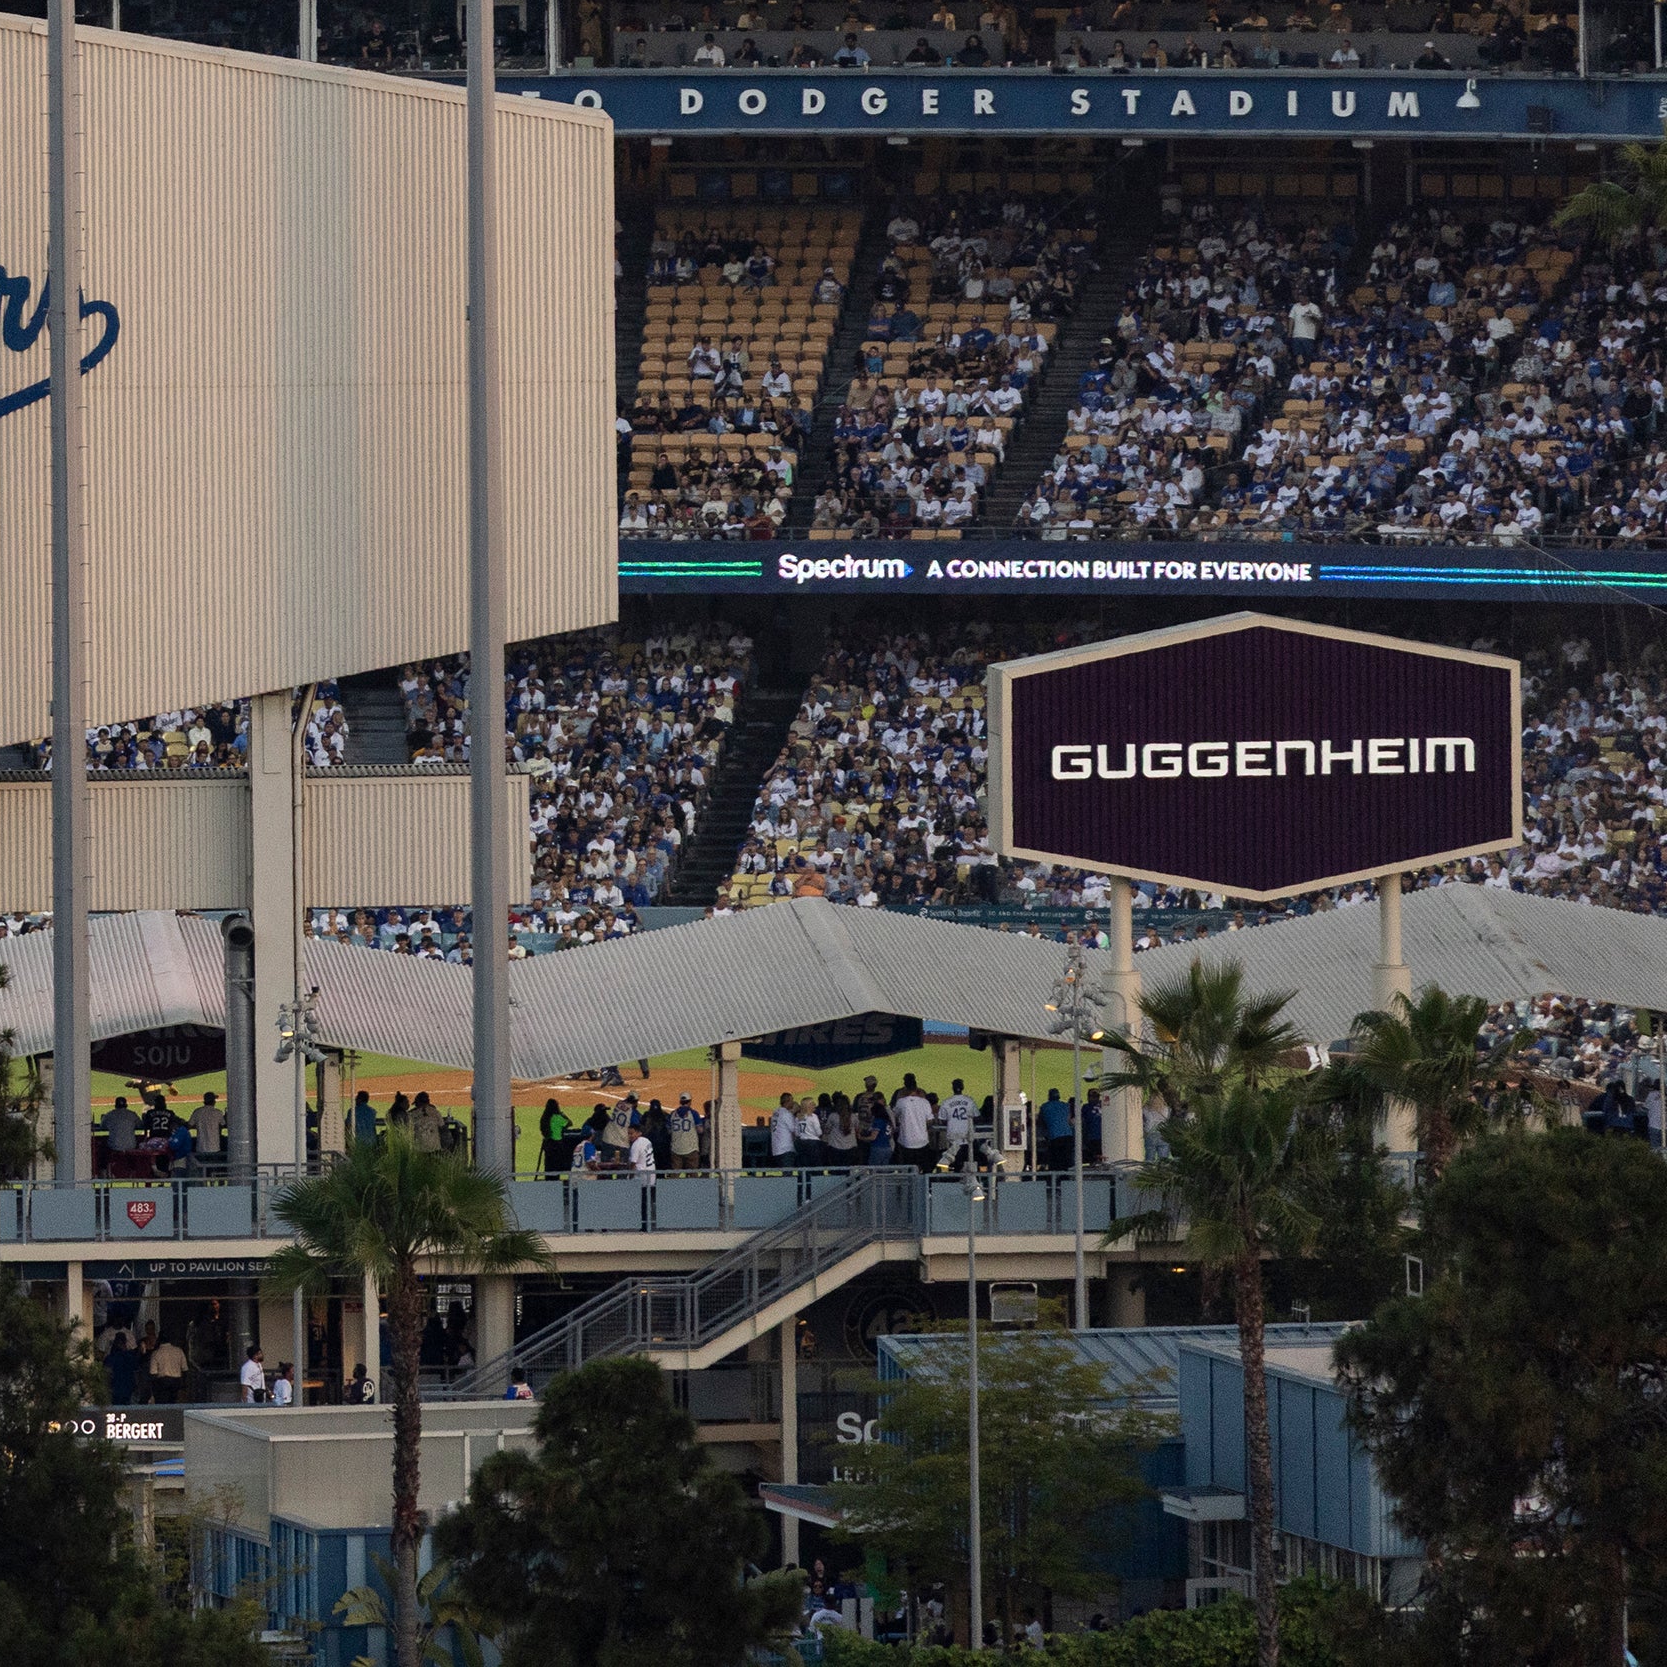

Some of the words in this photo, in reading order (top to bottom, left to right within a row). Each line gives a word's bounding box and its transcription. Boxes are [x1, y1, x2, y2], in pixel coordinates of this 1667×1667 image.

[681, 88, 997, 116] DODGER
[1071, 88, 1420, 119] STADIUM
[778, 554, 905, 584] Spectrum
[925, 560, 945, 579] A
[946, 559, 1089, 579] CONNECTION
[1092, 560, 1152, 580] BUILT
[1154, 561, 1196, 581] FOR
[1200, 561, 1313, 583] EVERYONE
[1051, 736, 1476, 781] GUGGENHEIM
[133, 1045, 192, 1067] SOJU
[952, 1107, 968, 1121] 42
[152, 1117, 169, 1130] 22
[672, 1118, 692, 1133] 50
[130, 1202, 150, 1213] 483
[149, 1262, 166, 1273] UP
[169, 1262, 186, 1273] TO
[189, 1261, 245, 1273] PAVILION
[106, 1423, 164, 1440] BERGERT
